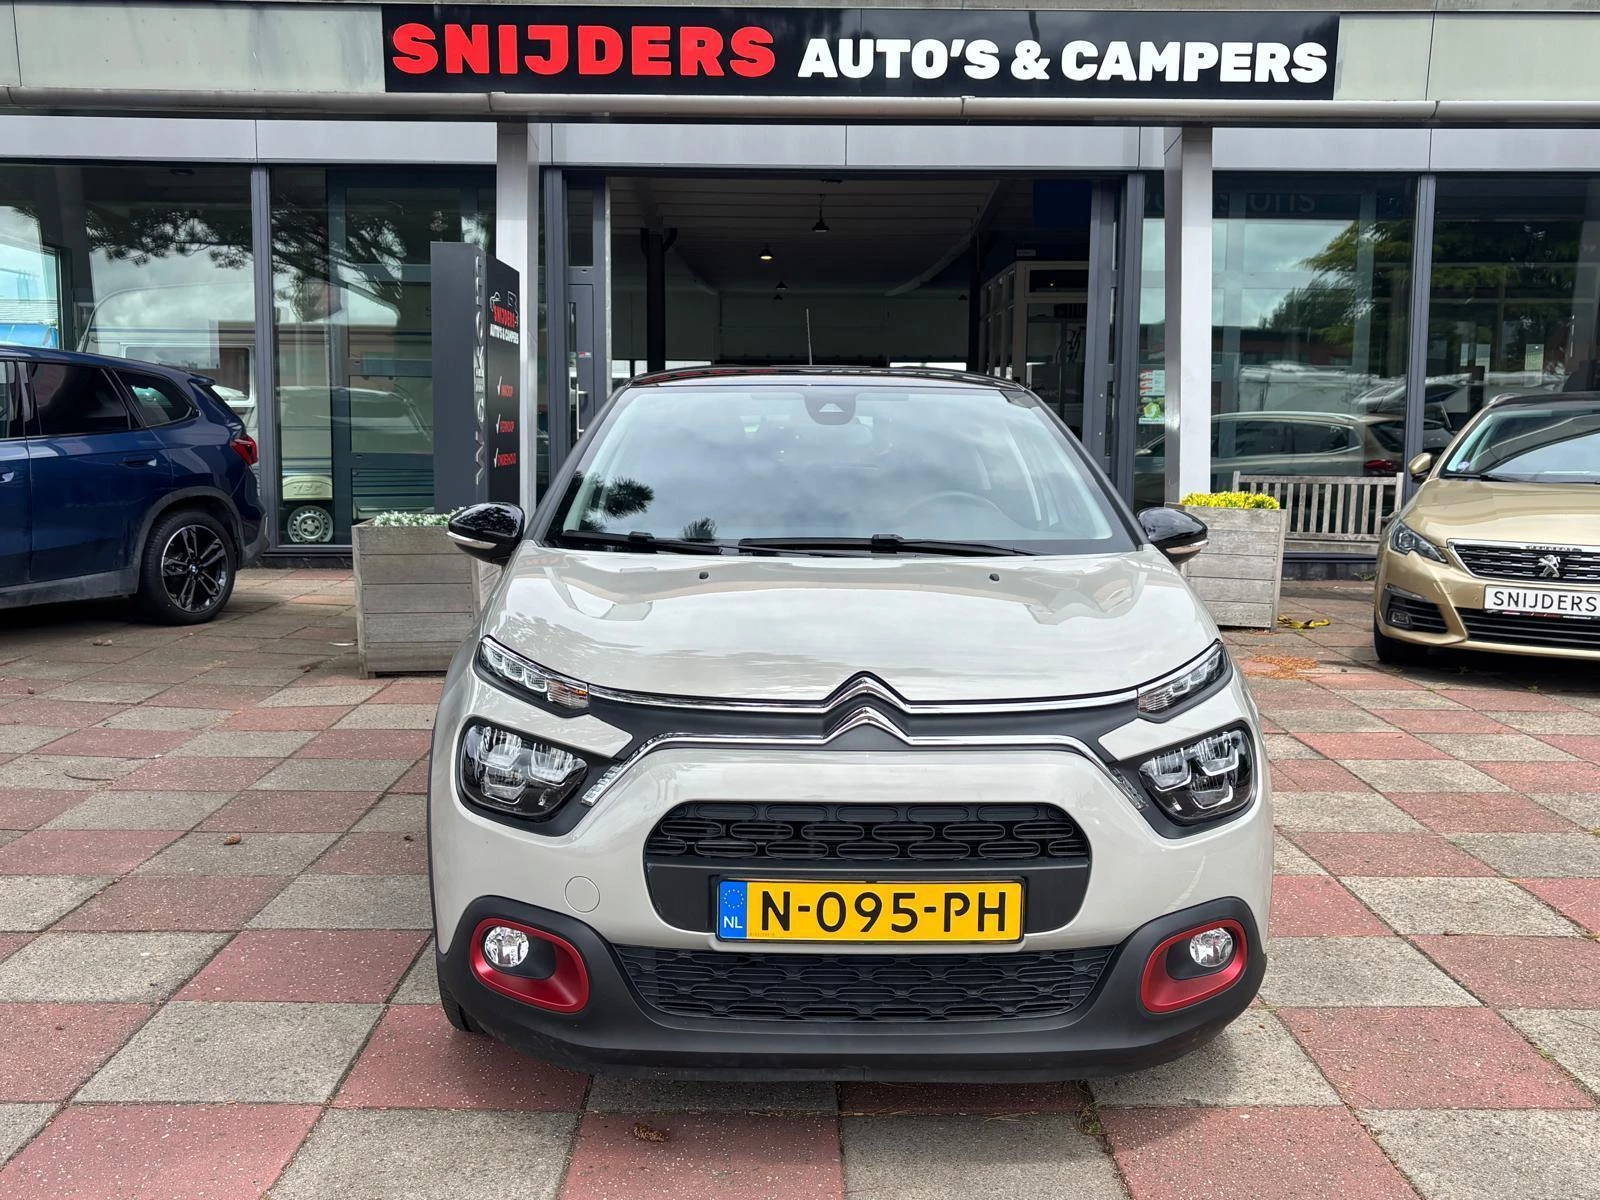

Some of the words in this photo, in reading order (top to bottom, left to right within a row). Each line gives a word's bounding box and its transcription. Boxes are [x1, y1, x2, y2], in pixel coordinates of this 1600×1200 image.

[392, 23, 775, 77] SNIJDERS
[798, 38, 999, 79] AUTO'S
[1010, 39, 1050, 80] &
[1061, 40, 1327, 83] CAMPERS
[1493, 590, 1598, 612] SNIJDERS
[723, 915, 743, 929] NL
[761, 890, 1007, 933] N-095-PH
